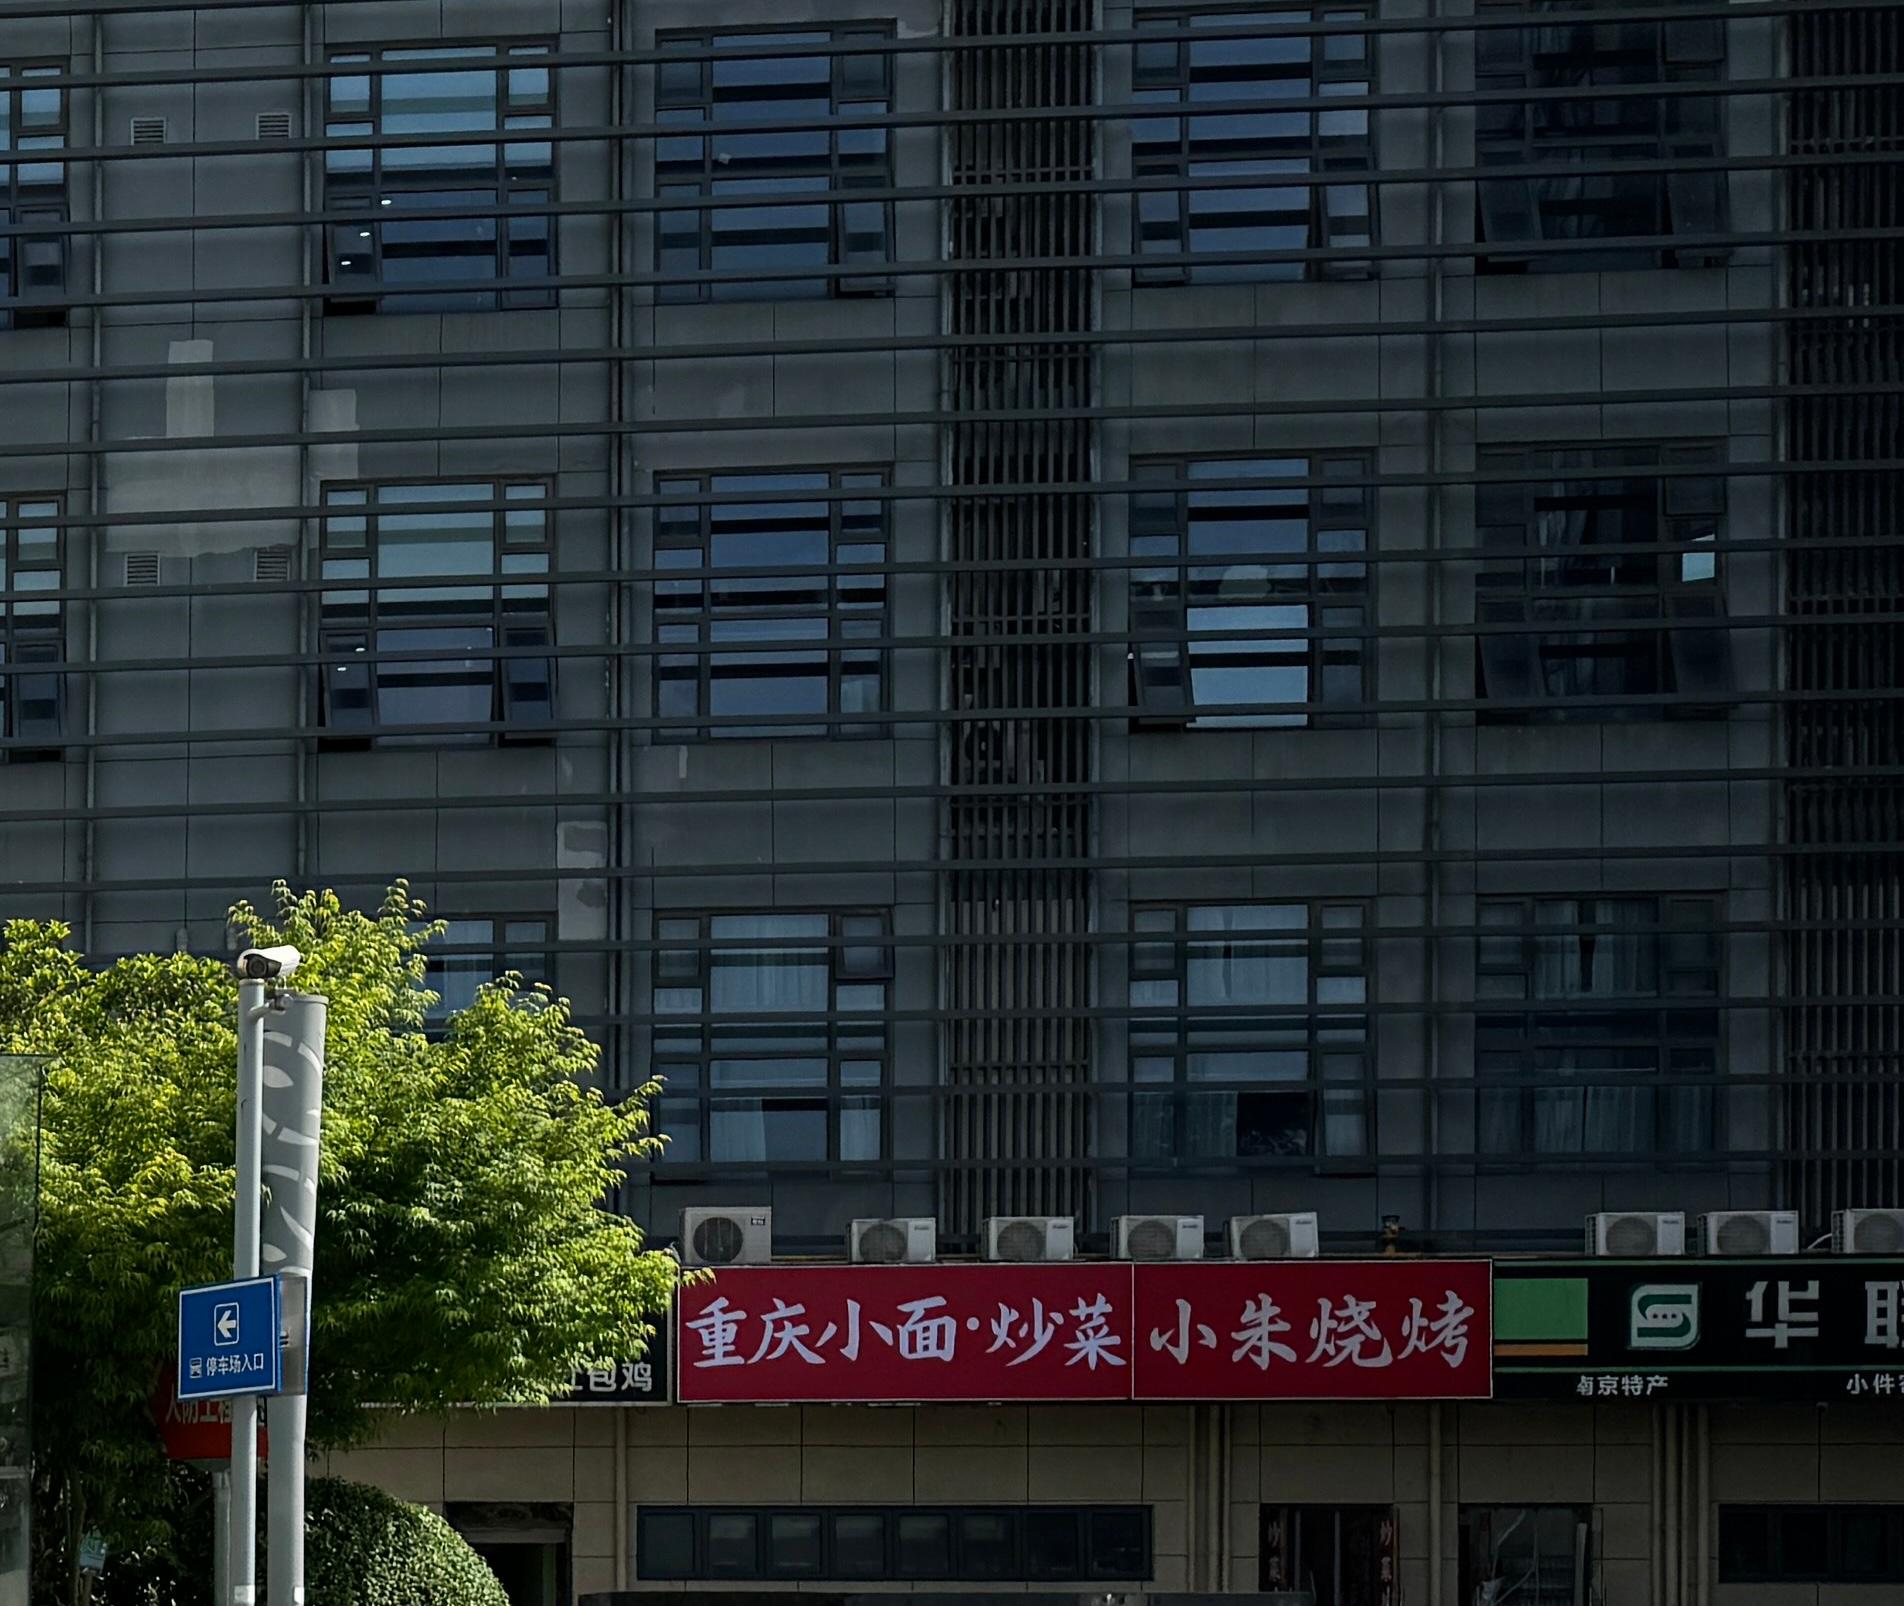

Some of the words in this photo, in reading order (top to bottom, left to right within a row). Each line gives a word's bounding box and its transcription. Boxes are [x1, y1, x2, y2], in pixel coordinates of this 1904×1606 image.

[686, 1293, 1127, 1371] 重庆小面·炒菜
[1150, 1290, 1475, 1371] 小朱烧烤
[206, 1353, 264, 1376] 停车场入口
[1846, 1373, 1904, 1395] 小件
